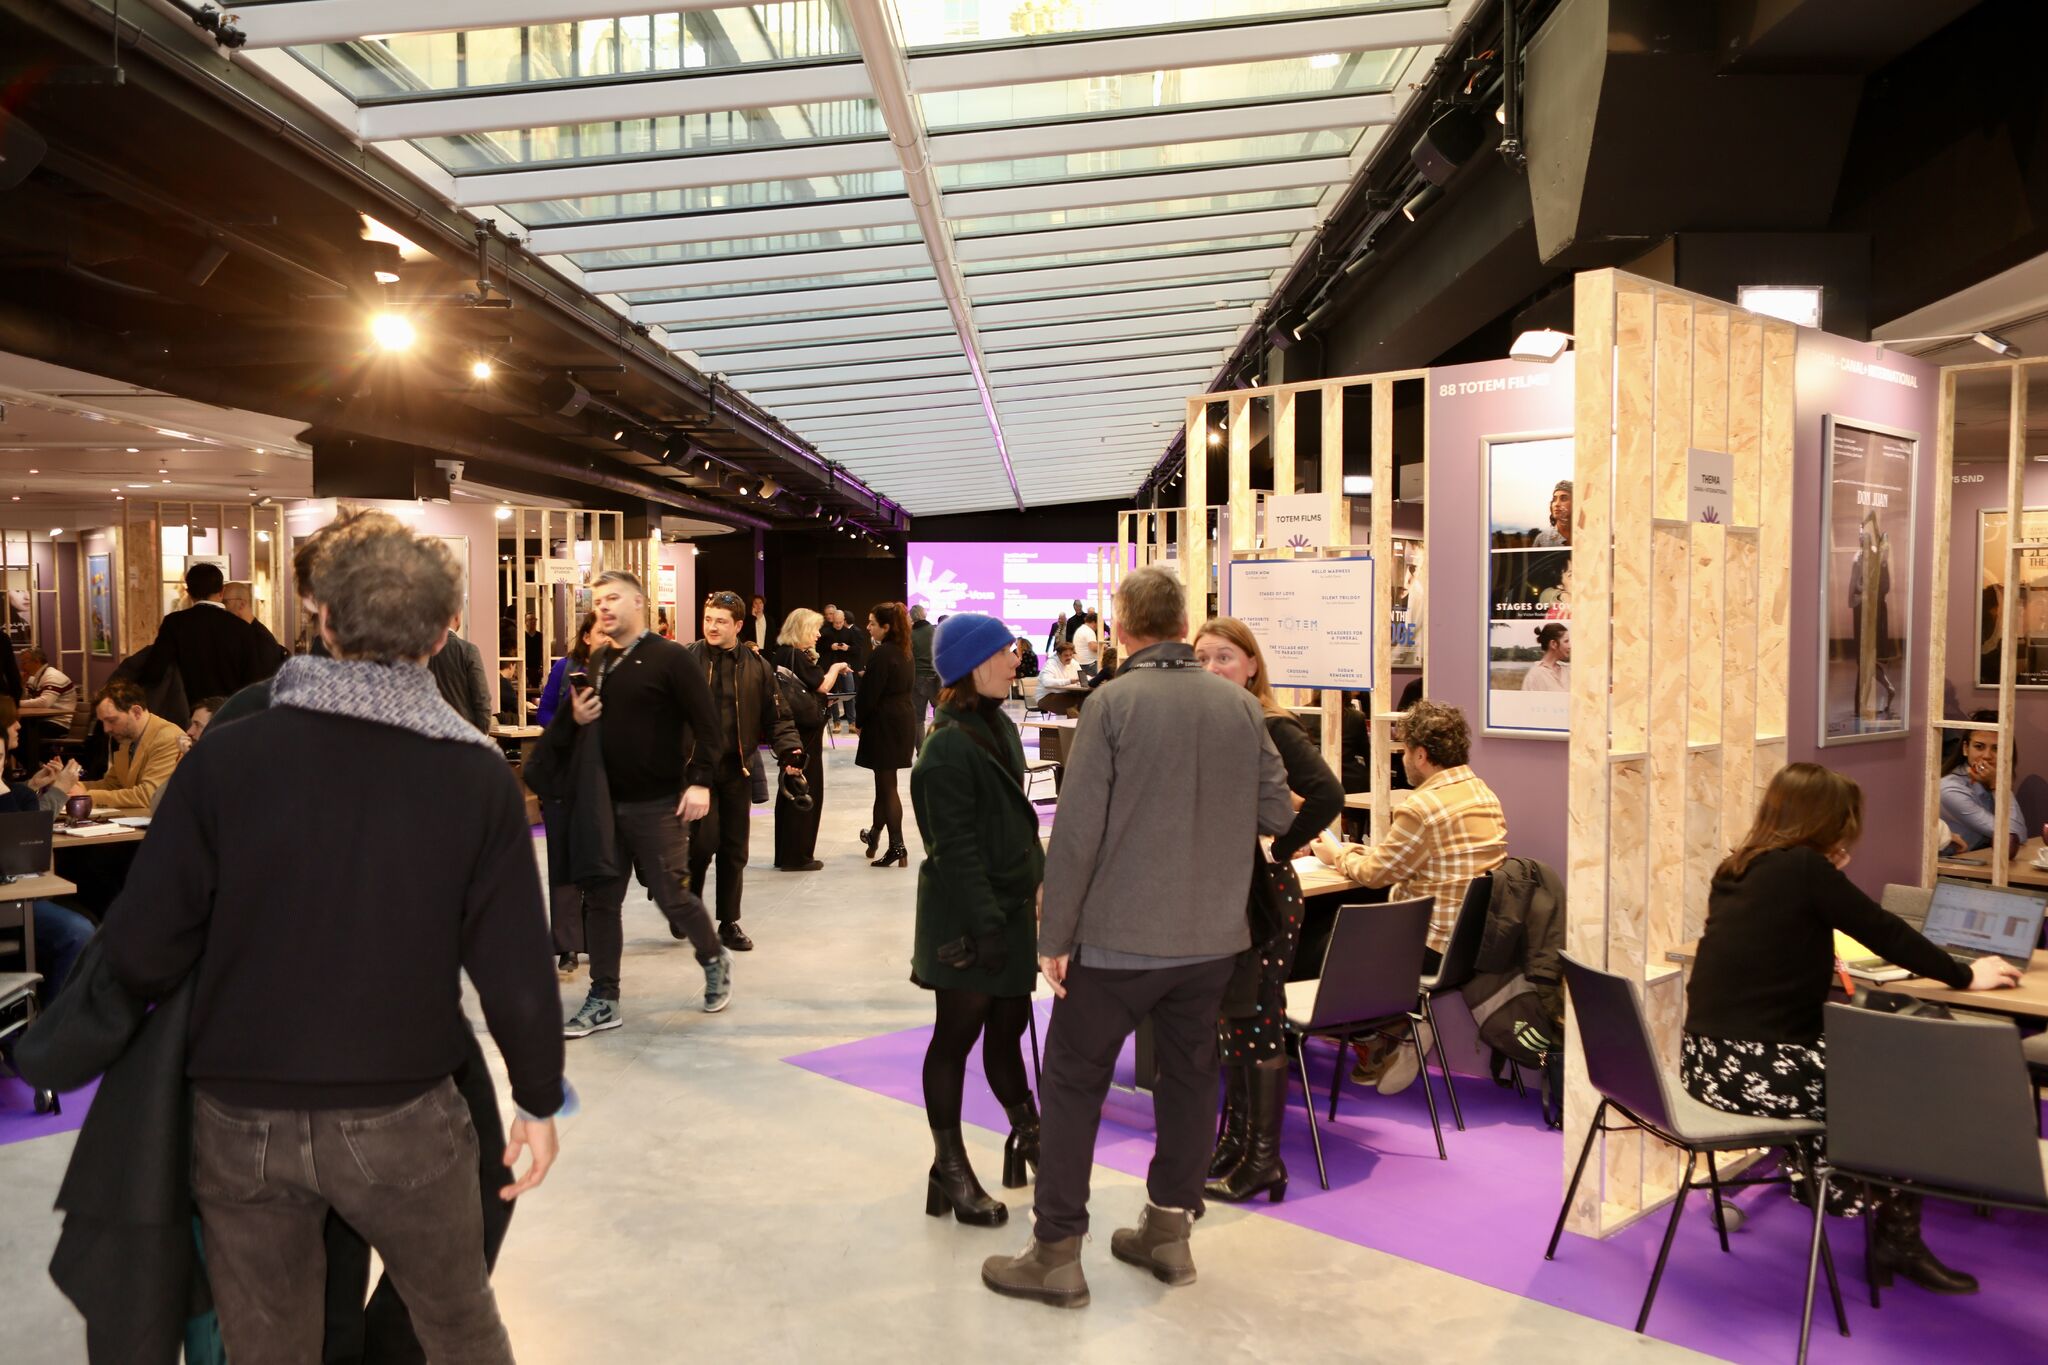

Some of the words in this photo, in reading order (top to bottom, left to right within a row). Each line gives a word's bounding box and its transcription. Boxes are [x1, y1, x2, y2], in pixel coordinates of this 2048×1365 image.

[1440, 383, 1457, 397] 88
[1458, 378, 1506, 394] TOTEM
[1508, 372, 1552, 389] FILMS
[1702, 474, 1720, 485] THEMA
[1952, 475, 1960, 483] 5
[1961, 474, 1984, 483] SND
[1857, 490, 1870, 505] DON
[1872, 492, 1888, 507] JUAN
[1276, 515, 1300, 523] TOTEM
[1301, 514, 1322, 522] FILMS
[1496, 602, 1533, 611] STAGES
[1535, 602, 1549, 611] OF
[1278, 617, 1318, 629] TOTEM
